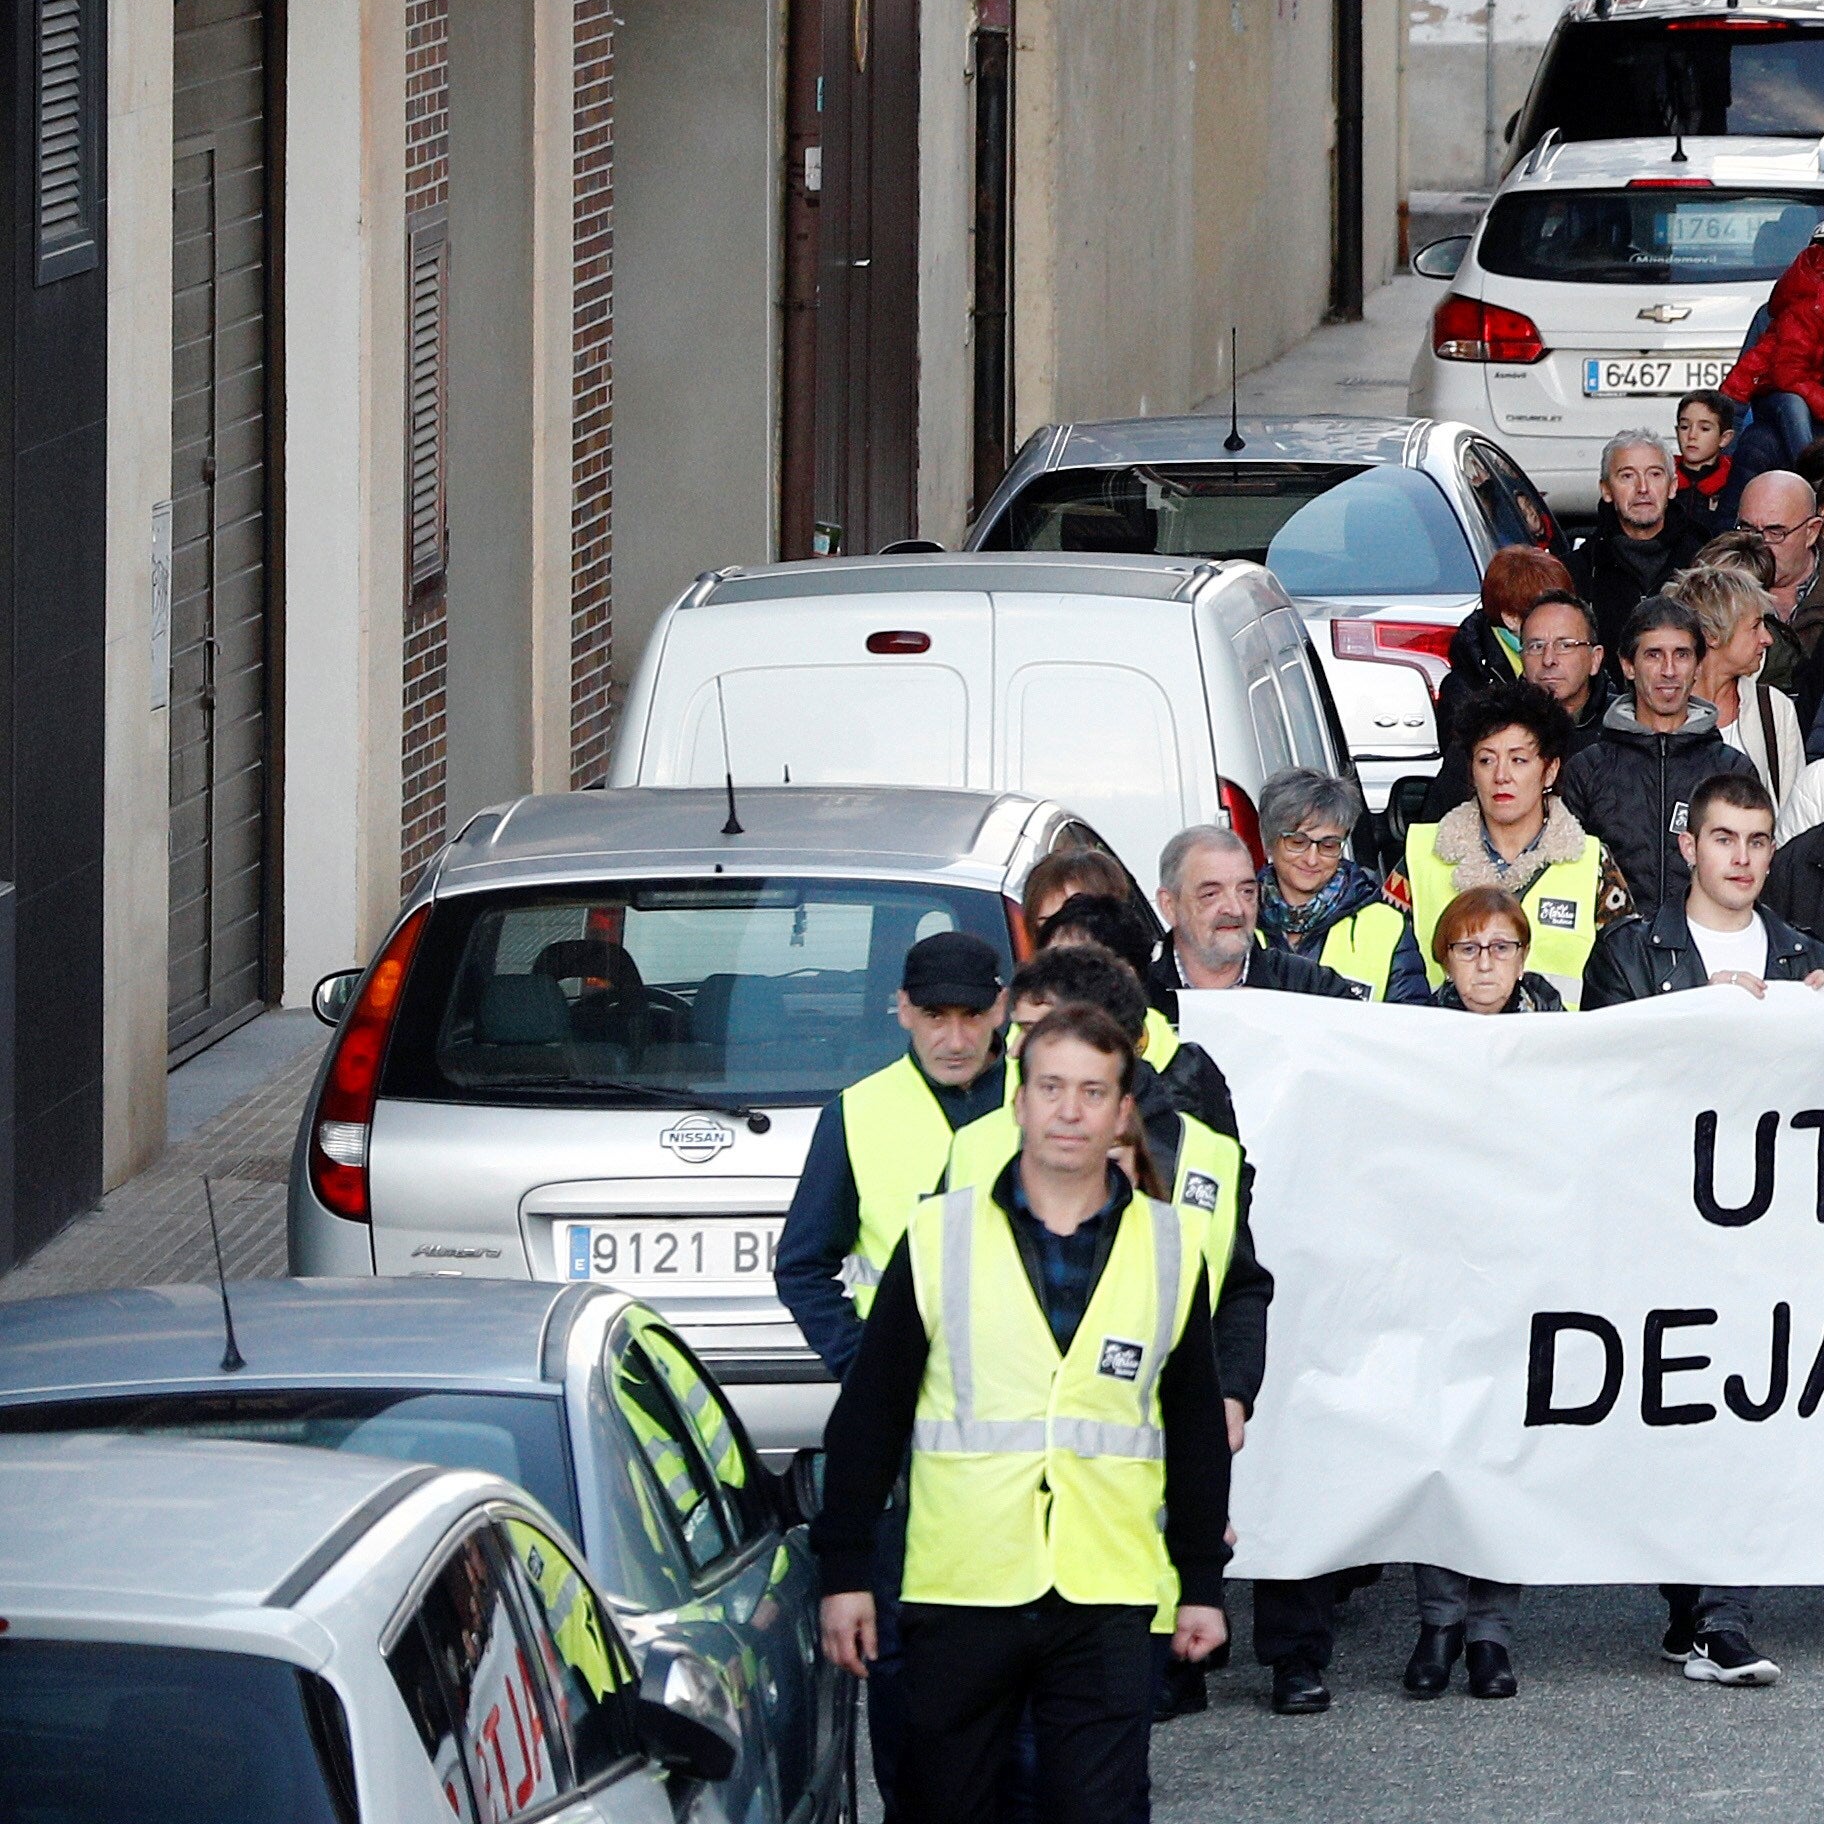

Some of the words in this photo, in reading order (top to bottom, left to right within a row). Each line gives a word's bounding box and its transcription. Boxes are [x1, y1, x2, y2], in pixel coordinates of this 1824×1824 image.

[1605, 362, 1672, 387] 6467
[668, 1132, 726, 1144] NISSAN
[592, 1231, 704, 1274] 9121
[574, 1258, 586, 1271] E
